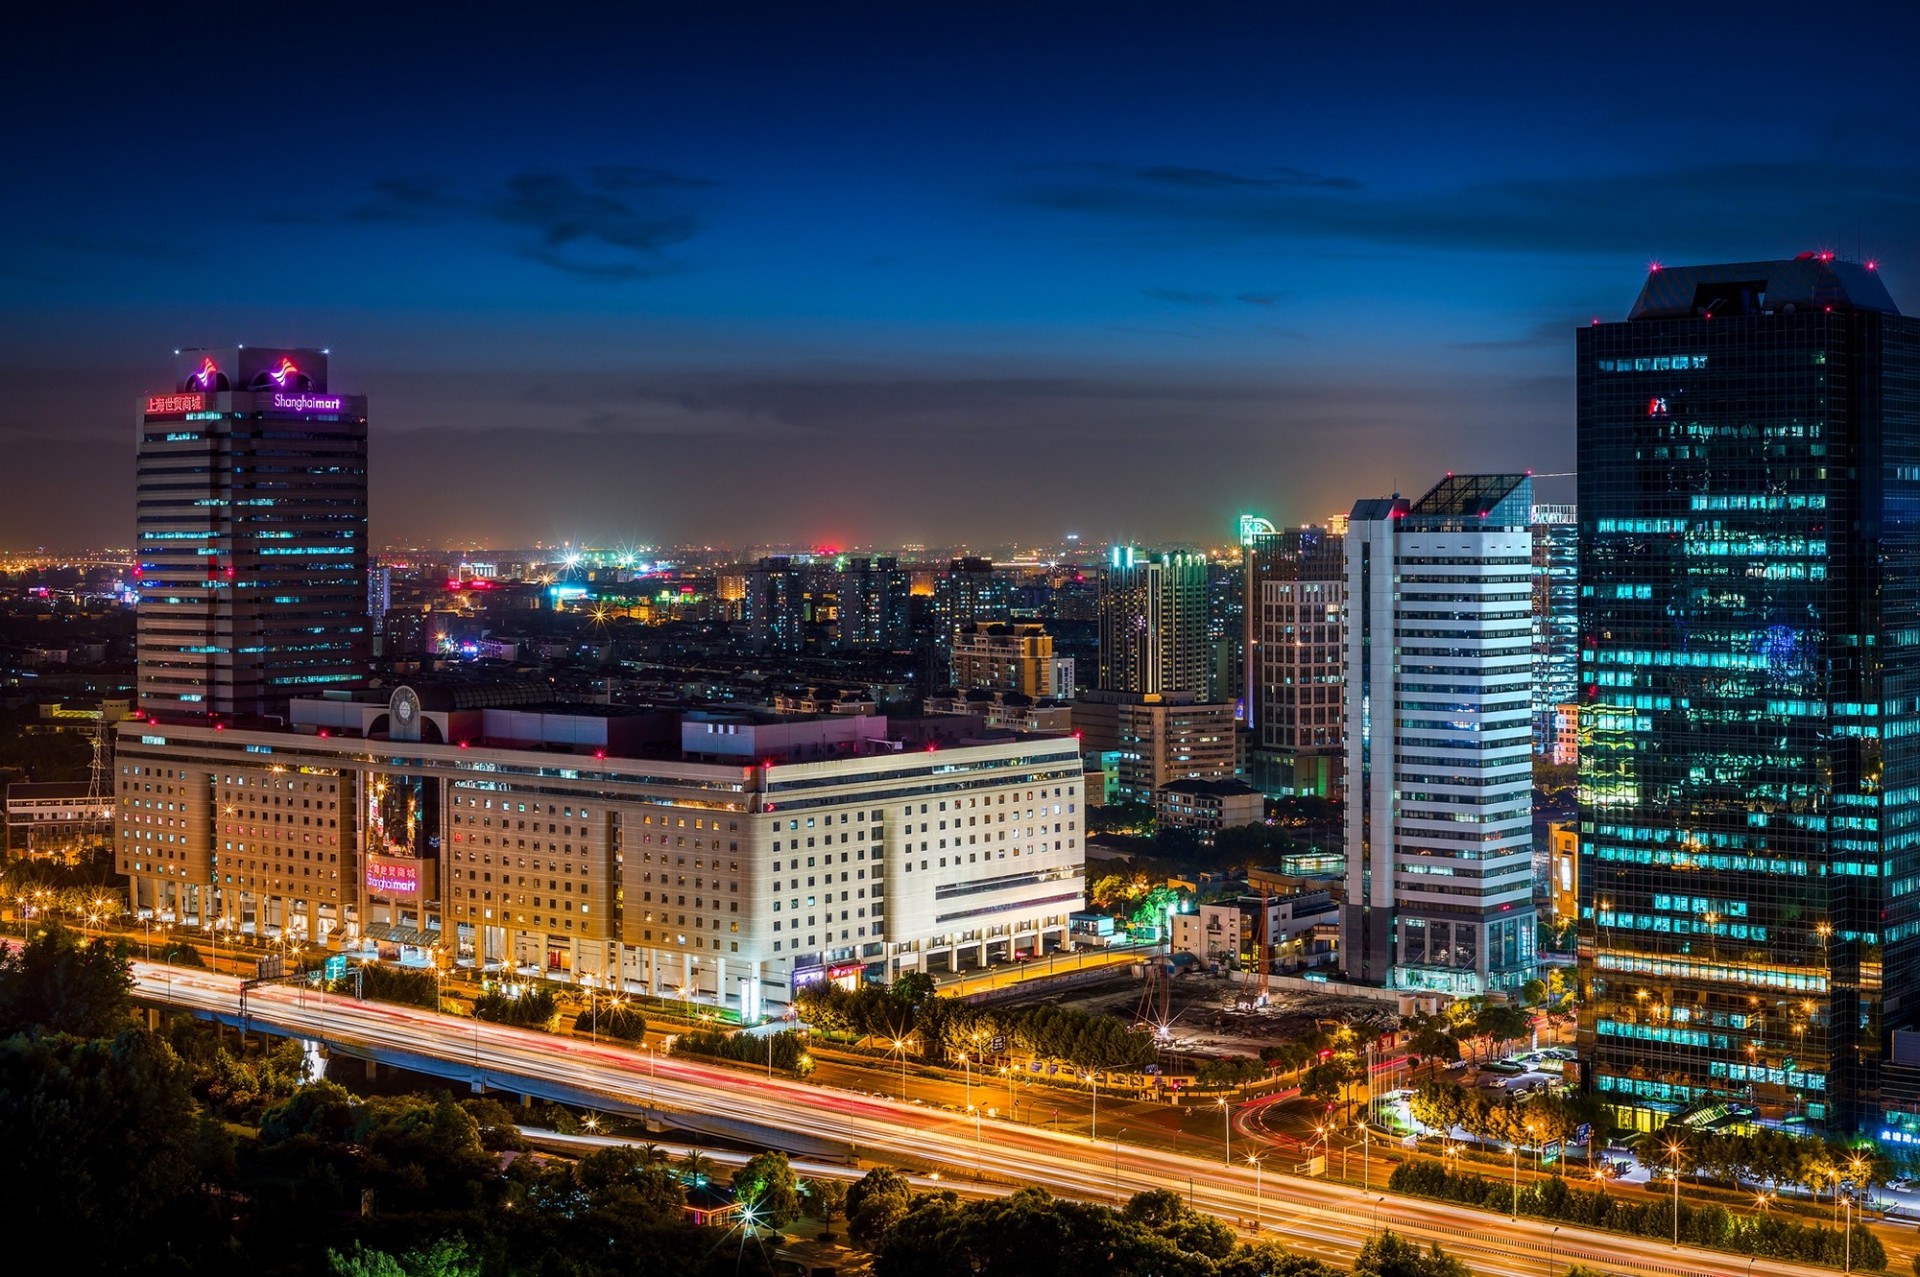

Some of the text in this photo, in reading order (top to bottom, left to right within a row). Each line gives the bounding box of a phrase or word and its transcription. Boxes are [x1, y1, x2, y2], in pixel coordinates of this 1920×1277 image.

[146, 395, 201, 412] 上海世贸商城
[274, 393, 340, 411] Shanghaimart
